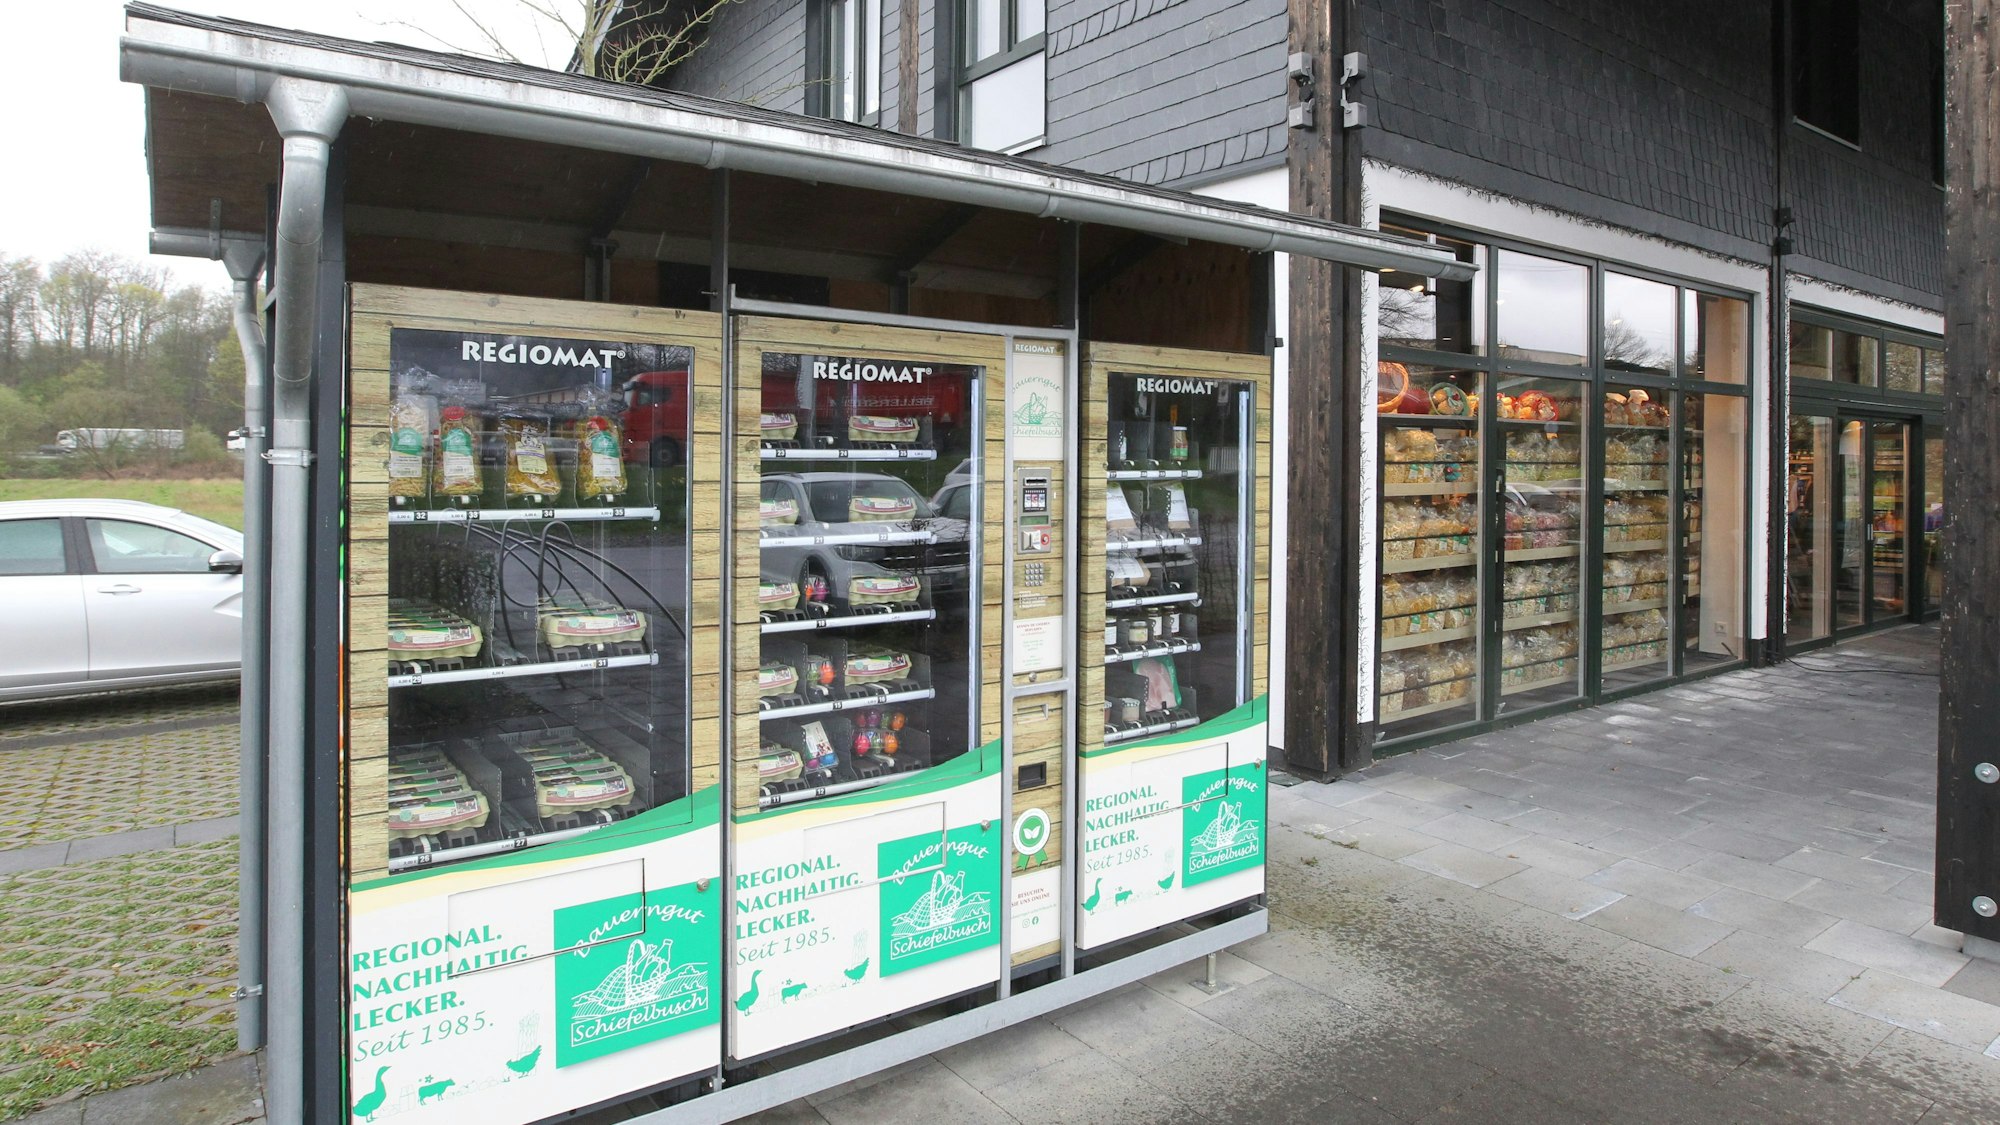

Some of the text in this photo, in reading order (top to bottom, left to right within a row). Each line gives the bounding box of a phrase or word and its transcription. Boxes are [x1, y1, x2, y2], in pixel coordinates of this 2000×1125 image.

[1015, 344, 1055, 354] REGIOMAT
[1012, 426, 1060, 437] chiefelbusch
[1086, 785, 1157, 812] REGIONAL.
[515, 840, 526, 848] 27
[1086, 829, 1139, 853] LECKER.
[1191, 842, 1257, 871] Schiefelbusch
[736, 854, 841, 890] REGIONAL.
[1085, 844, 1152, 874] Seit 1985.
[736, 909, 815, 940] LECKER.
[892, 918, 989, 956] Schiefelbusch
[353, 924, 502, 972] REGIONAL.
[736, 926, 835, 965] Seit 1985.
[354, 990, 465, 1032] LECKER.
[574, 993, 705, 1042] Schiefelbusch
[354, 1010, 493, 1062] Seit 1985.
